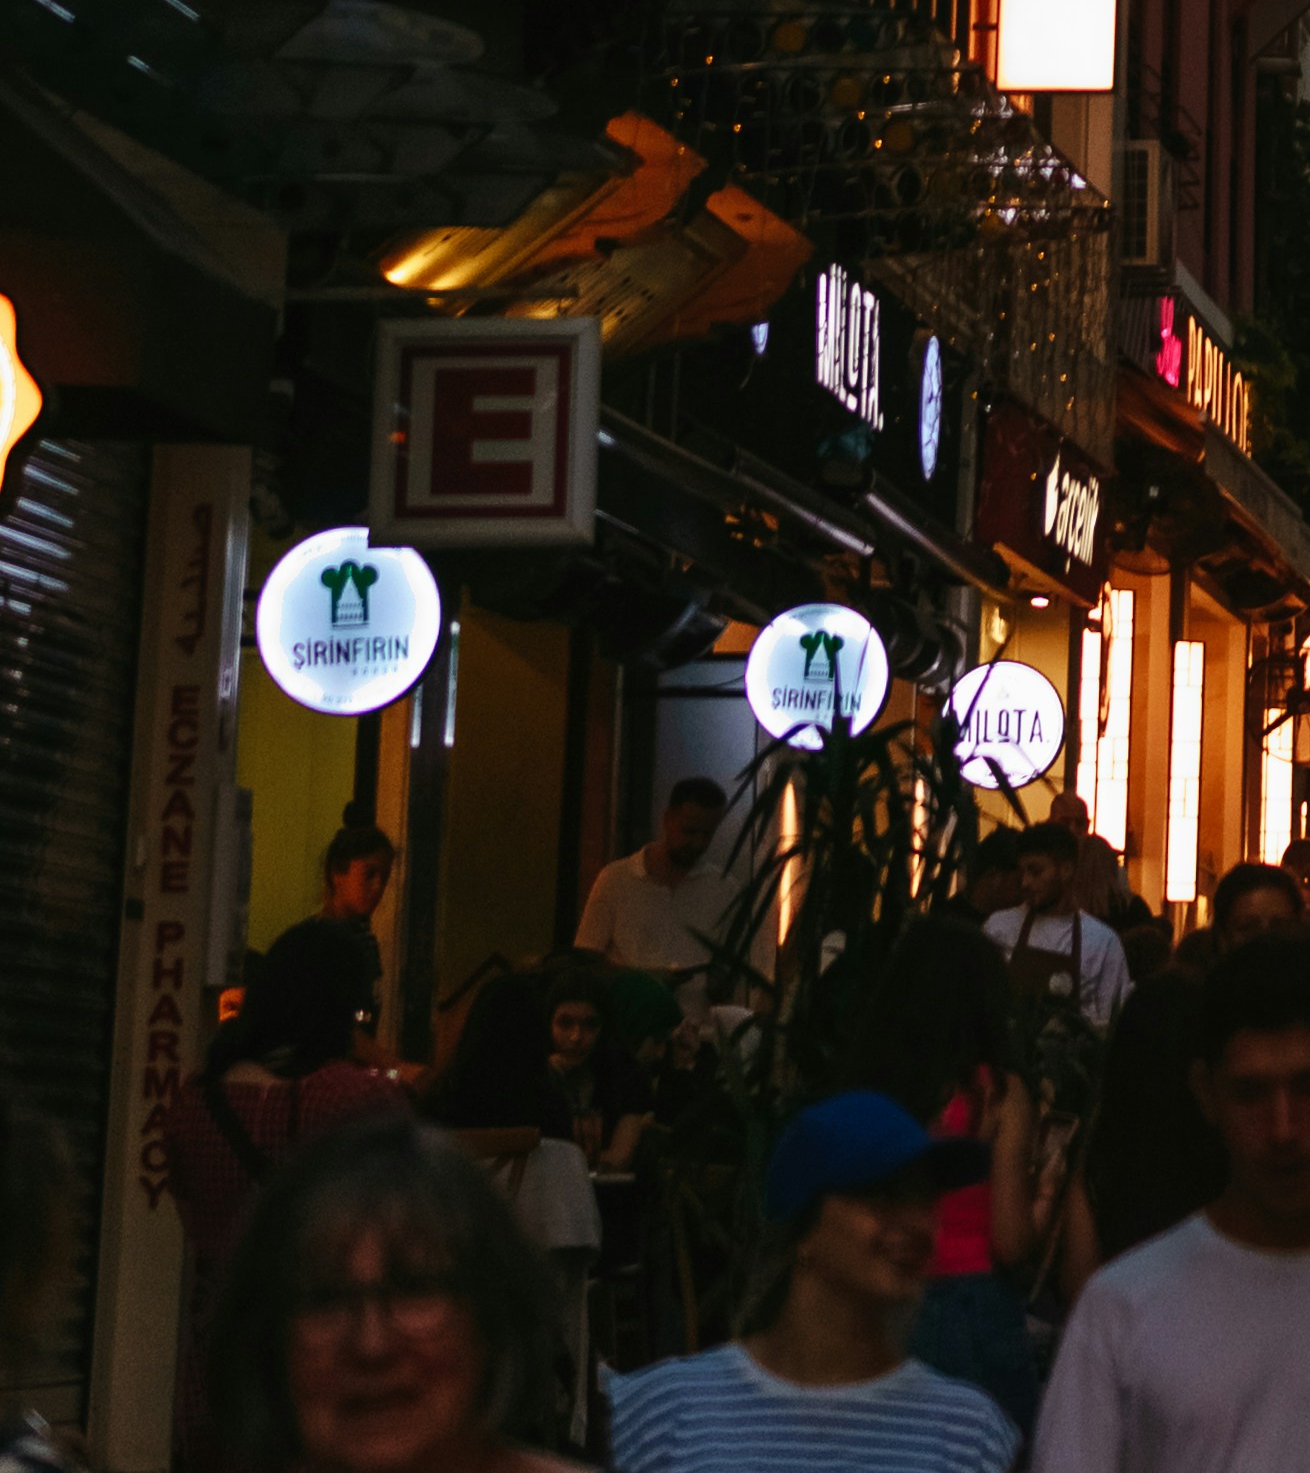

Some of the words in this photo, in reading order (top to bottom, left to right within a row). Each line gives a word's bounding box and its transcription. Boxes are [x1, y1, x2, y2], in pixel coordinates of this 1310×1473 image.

[430, 367, 537, 495] E
[160, 684, 201, 893] ECZANE
[140, 920, 186, 1210] PHARMACY
